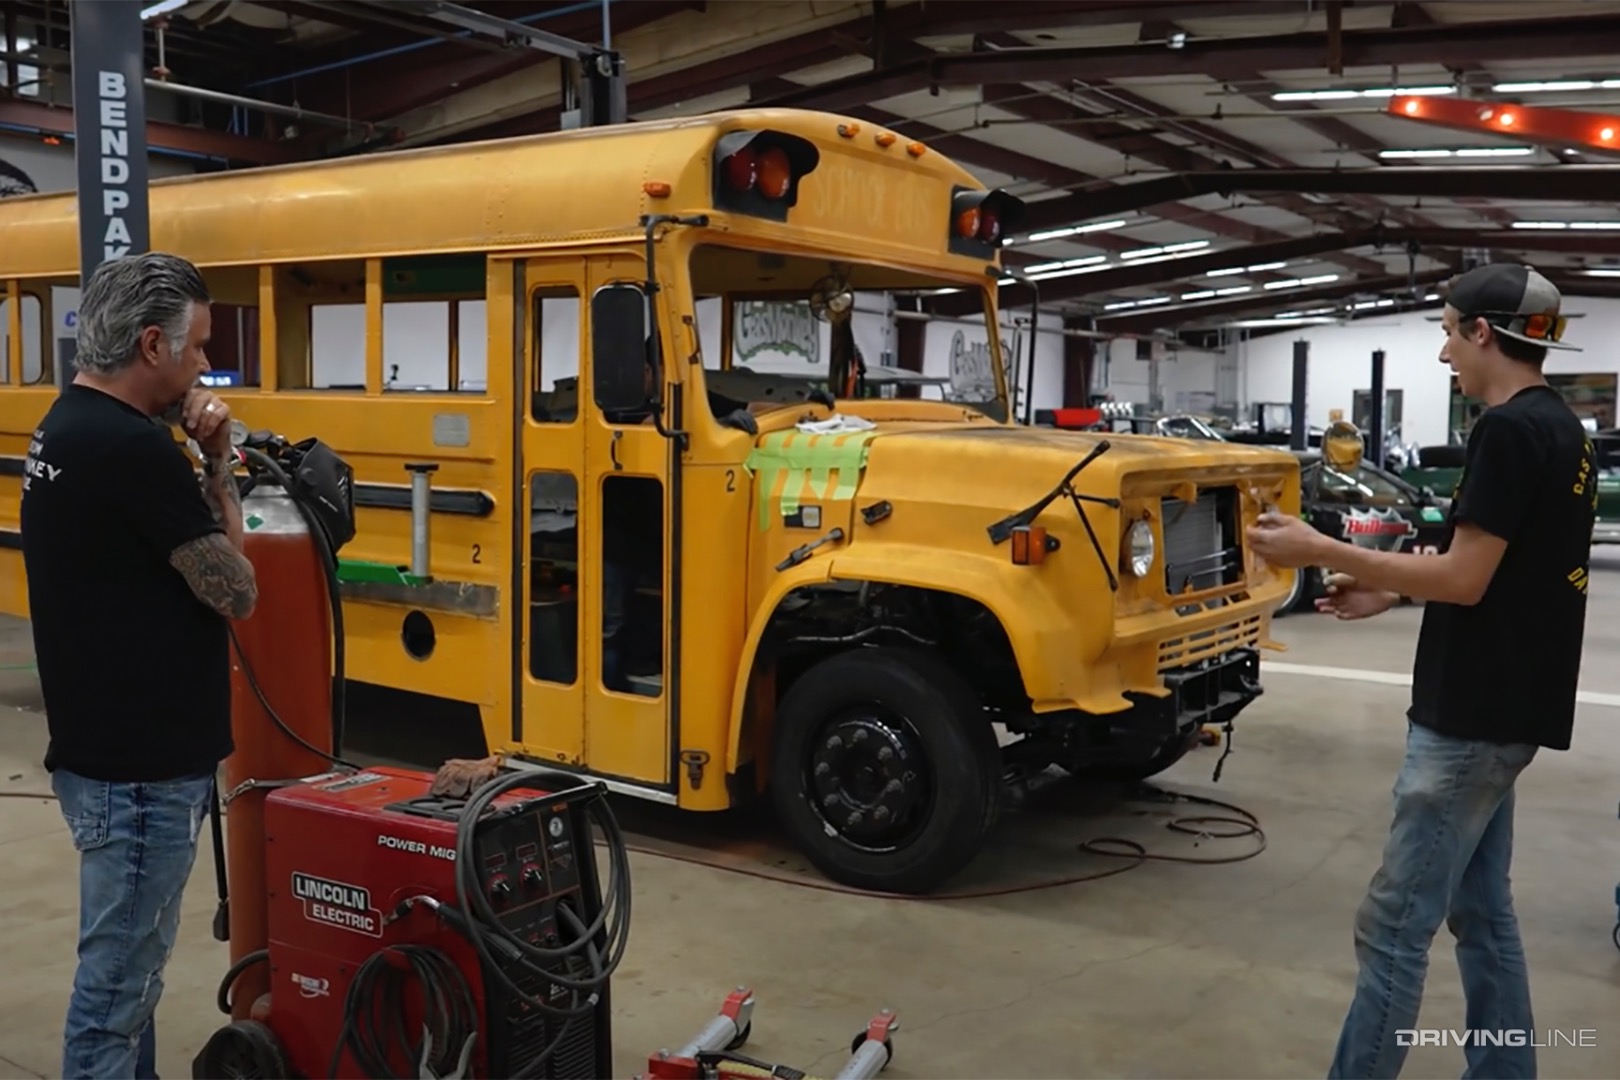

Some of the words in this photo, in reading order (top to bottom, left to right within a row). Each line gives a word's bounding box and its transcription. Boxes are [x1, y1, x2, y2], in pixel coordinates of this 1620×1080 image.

[726, 469, 736, 492] 2
[472, 543, 481, 564] 2
[378, 835, 426, 854] POWER
[429, 845, 457, 861] MIG
[296, 877, 365, 910] LINCOLN
[312, 904, 374, 931] ELECTRIC
